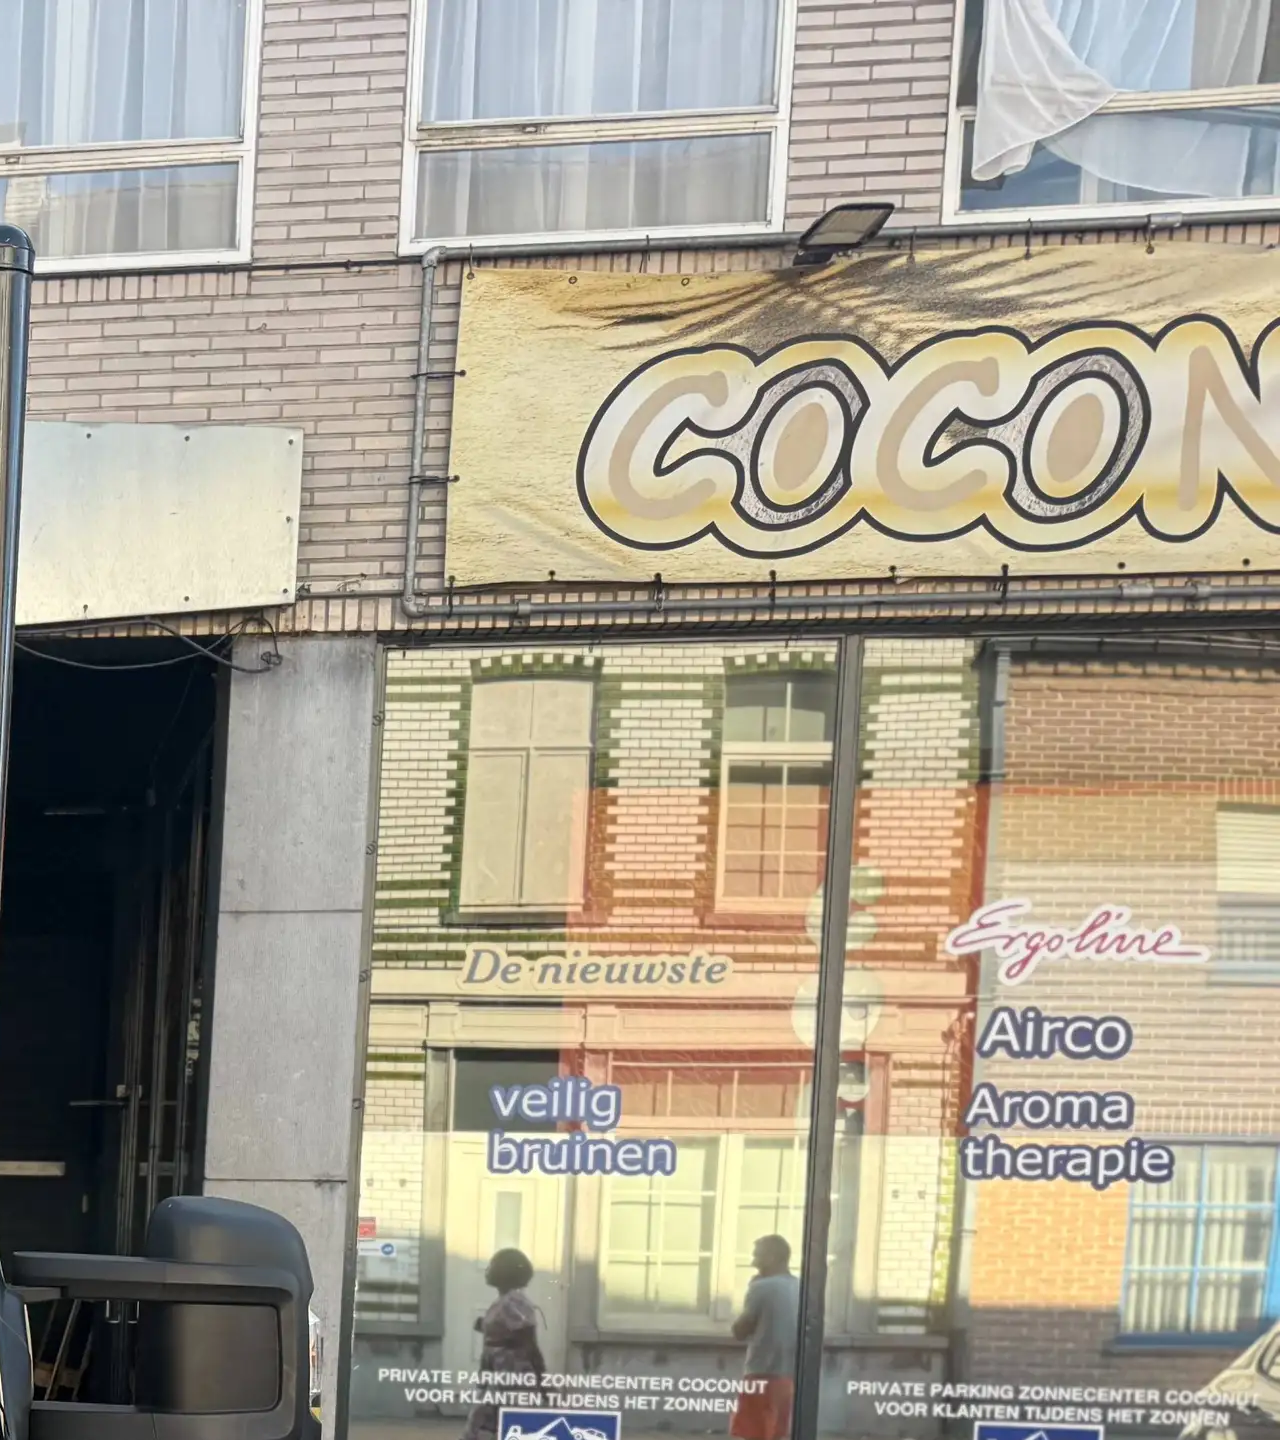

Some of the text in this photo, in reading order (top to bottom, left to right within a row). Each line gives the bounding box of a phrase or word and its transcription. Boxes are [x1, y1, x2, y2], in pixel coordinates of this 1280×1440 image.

[952, 903, 1205, 979] Ergoline
[463, 949, 728, 984] De nieuwste
[981, 1011, 1126, 1054] Airco
[493, 1081, 618, 1124] veilig
[966, 1089, 1129, 1124] Aroma
[492, 1133, 673, 1172] bruinen
[965, 1141, 1170, 1184] therapie
[378, 1368, 768, 1394] PRIVATE PARKING ZONNECENTER COCONUT
[847, 1381, 924, 1397] PRIVATE
[930, 1383, 1014, 1400] PARKING
[1019, 1385, 1160, 1404] ZONNECENTER
[405, 1388, 737, 1412] VOOR KLANTEN TIJDENS HET ZONNEN
[874, 1401, 1229, 1426] VOOR KLANTEN TIJDENS HET ZONNEN
